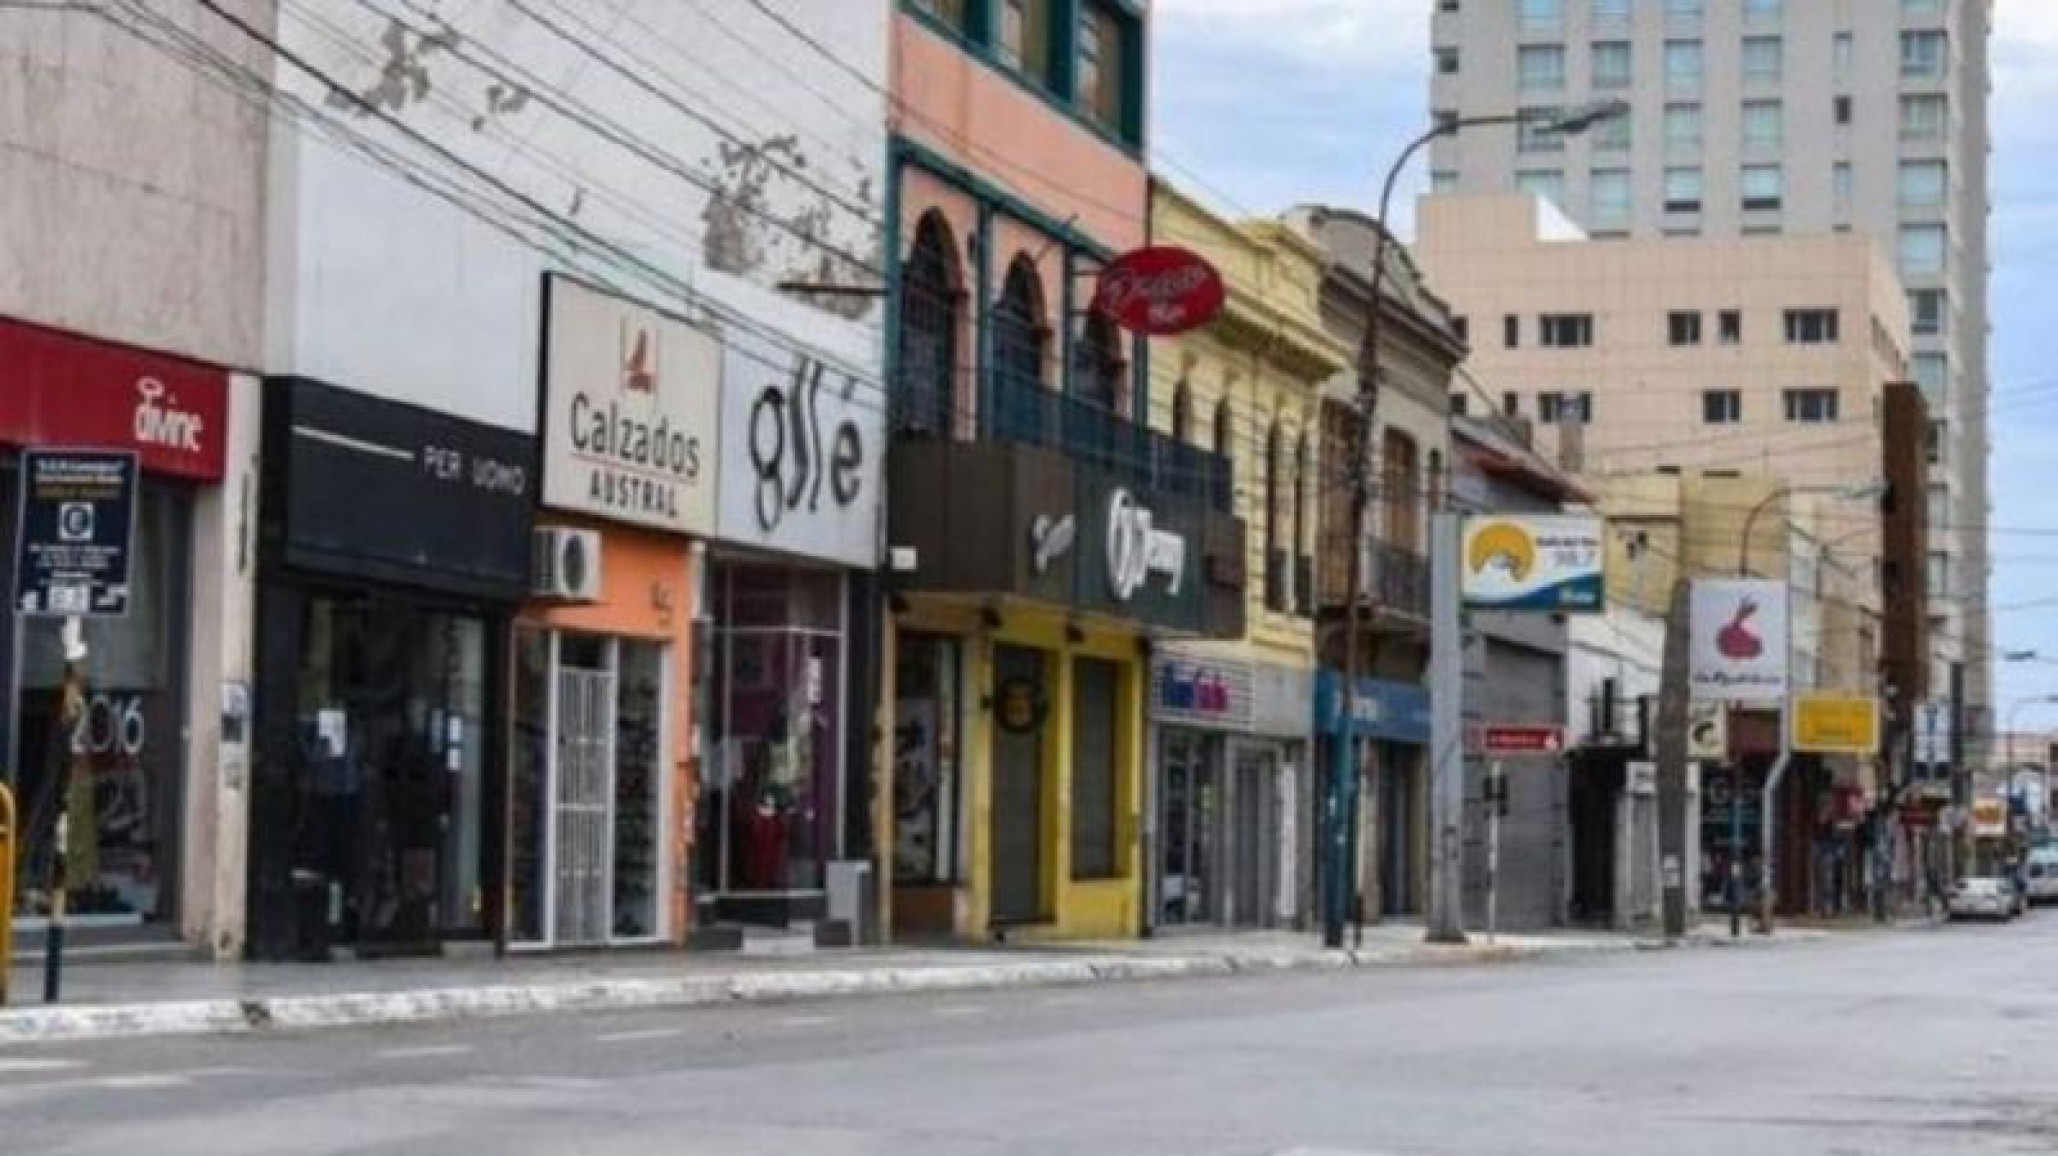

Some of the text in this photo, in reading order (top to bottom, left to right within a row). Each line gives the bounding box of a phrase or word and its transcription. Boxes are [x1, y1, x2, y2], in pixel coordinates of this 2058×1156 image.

[570, 391, 699, 478] Calzados
[424, 446, 461, 479] PER
[590, 468, 678, 518] AUSTRAL
